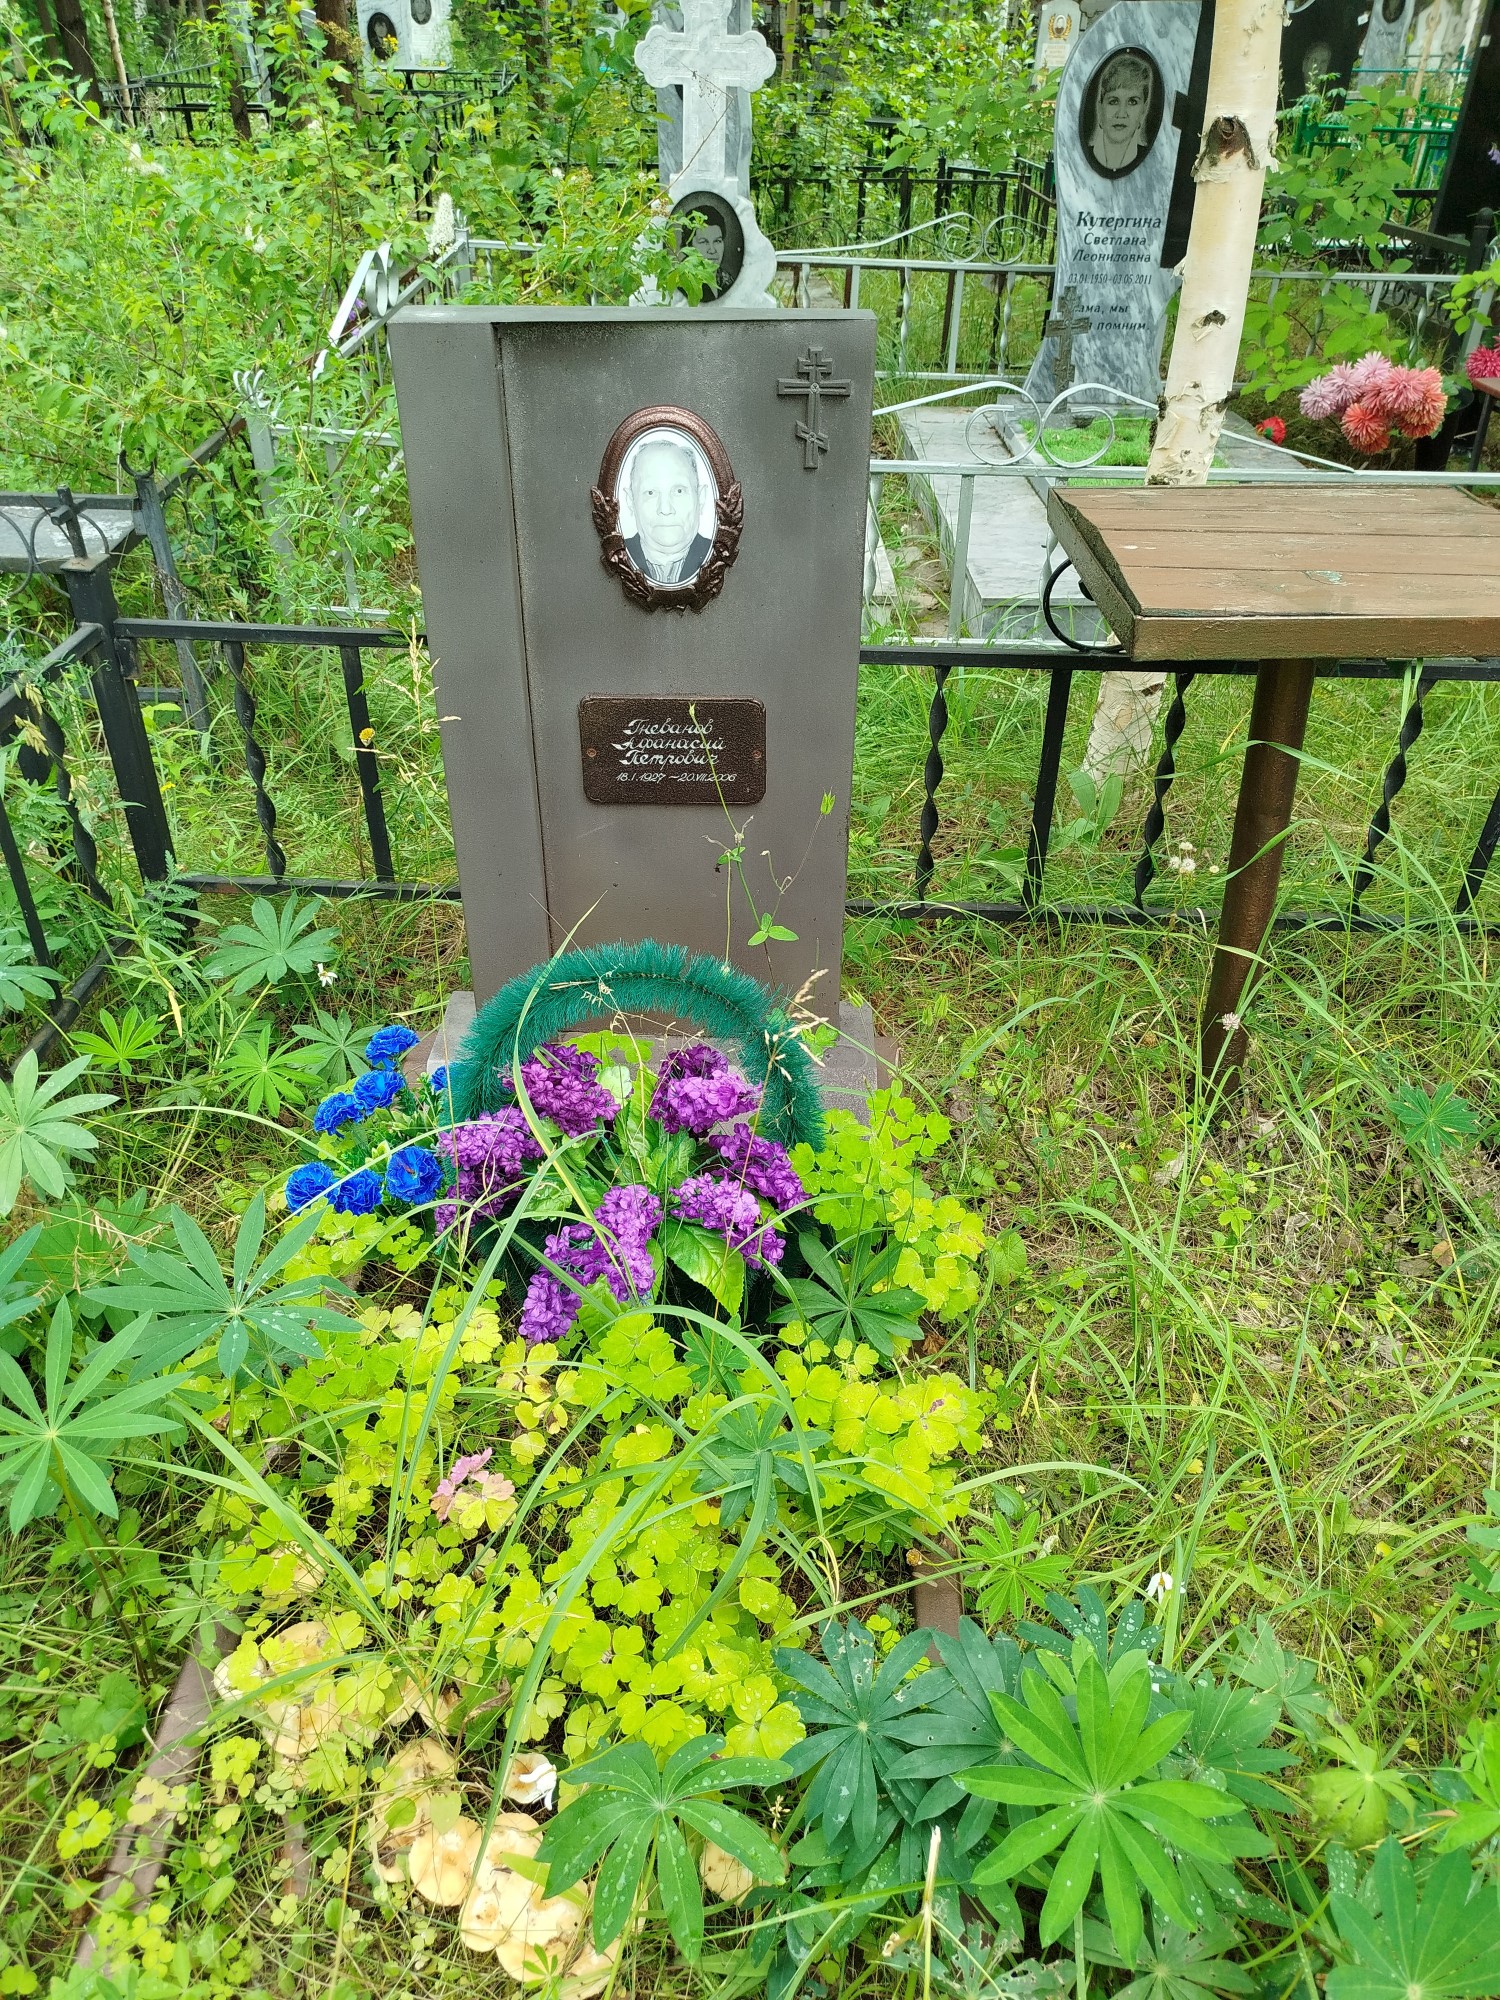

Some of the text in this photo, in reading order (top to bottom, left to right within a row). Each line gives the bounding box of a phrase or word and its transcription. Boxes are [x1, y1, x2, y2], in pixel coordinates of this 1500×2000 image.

[1076, 211, 1162, 231] Кутергина
[1083, 232, 1147, 246] Светлана
[1072, 250, 1151, 263] Леонидовна
[1074, 304, 1129, 314] ама, мы
[1096, 322, 1150, 331] помним.
[622, 717, 714, 735] Гневанов
[610, 737, 726, 750] Афанасий
[619, 749, 719, 770] Петрович
